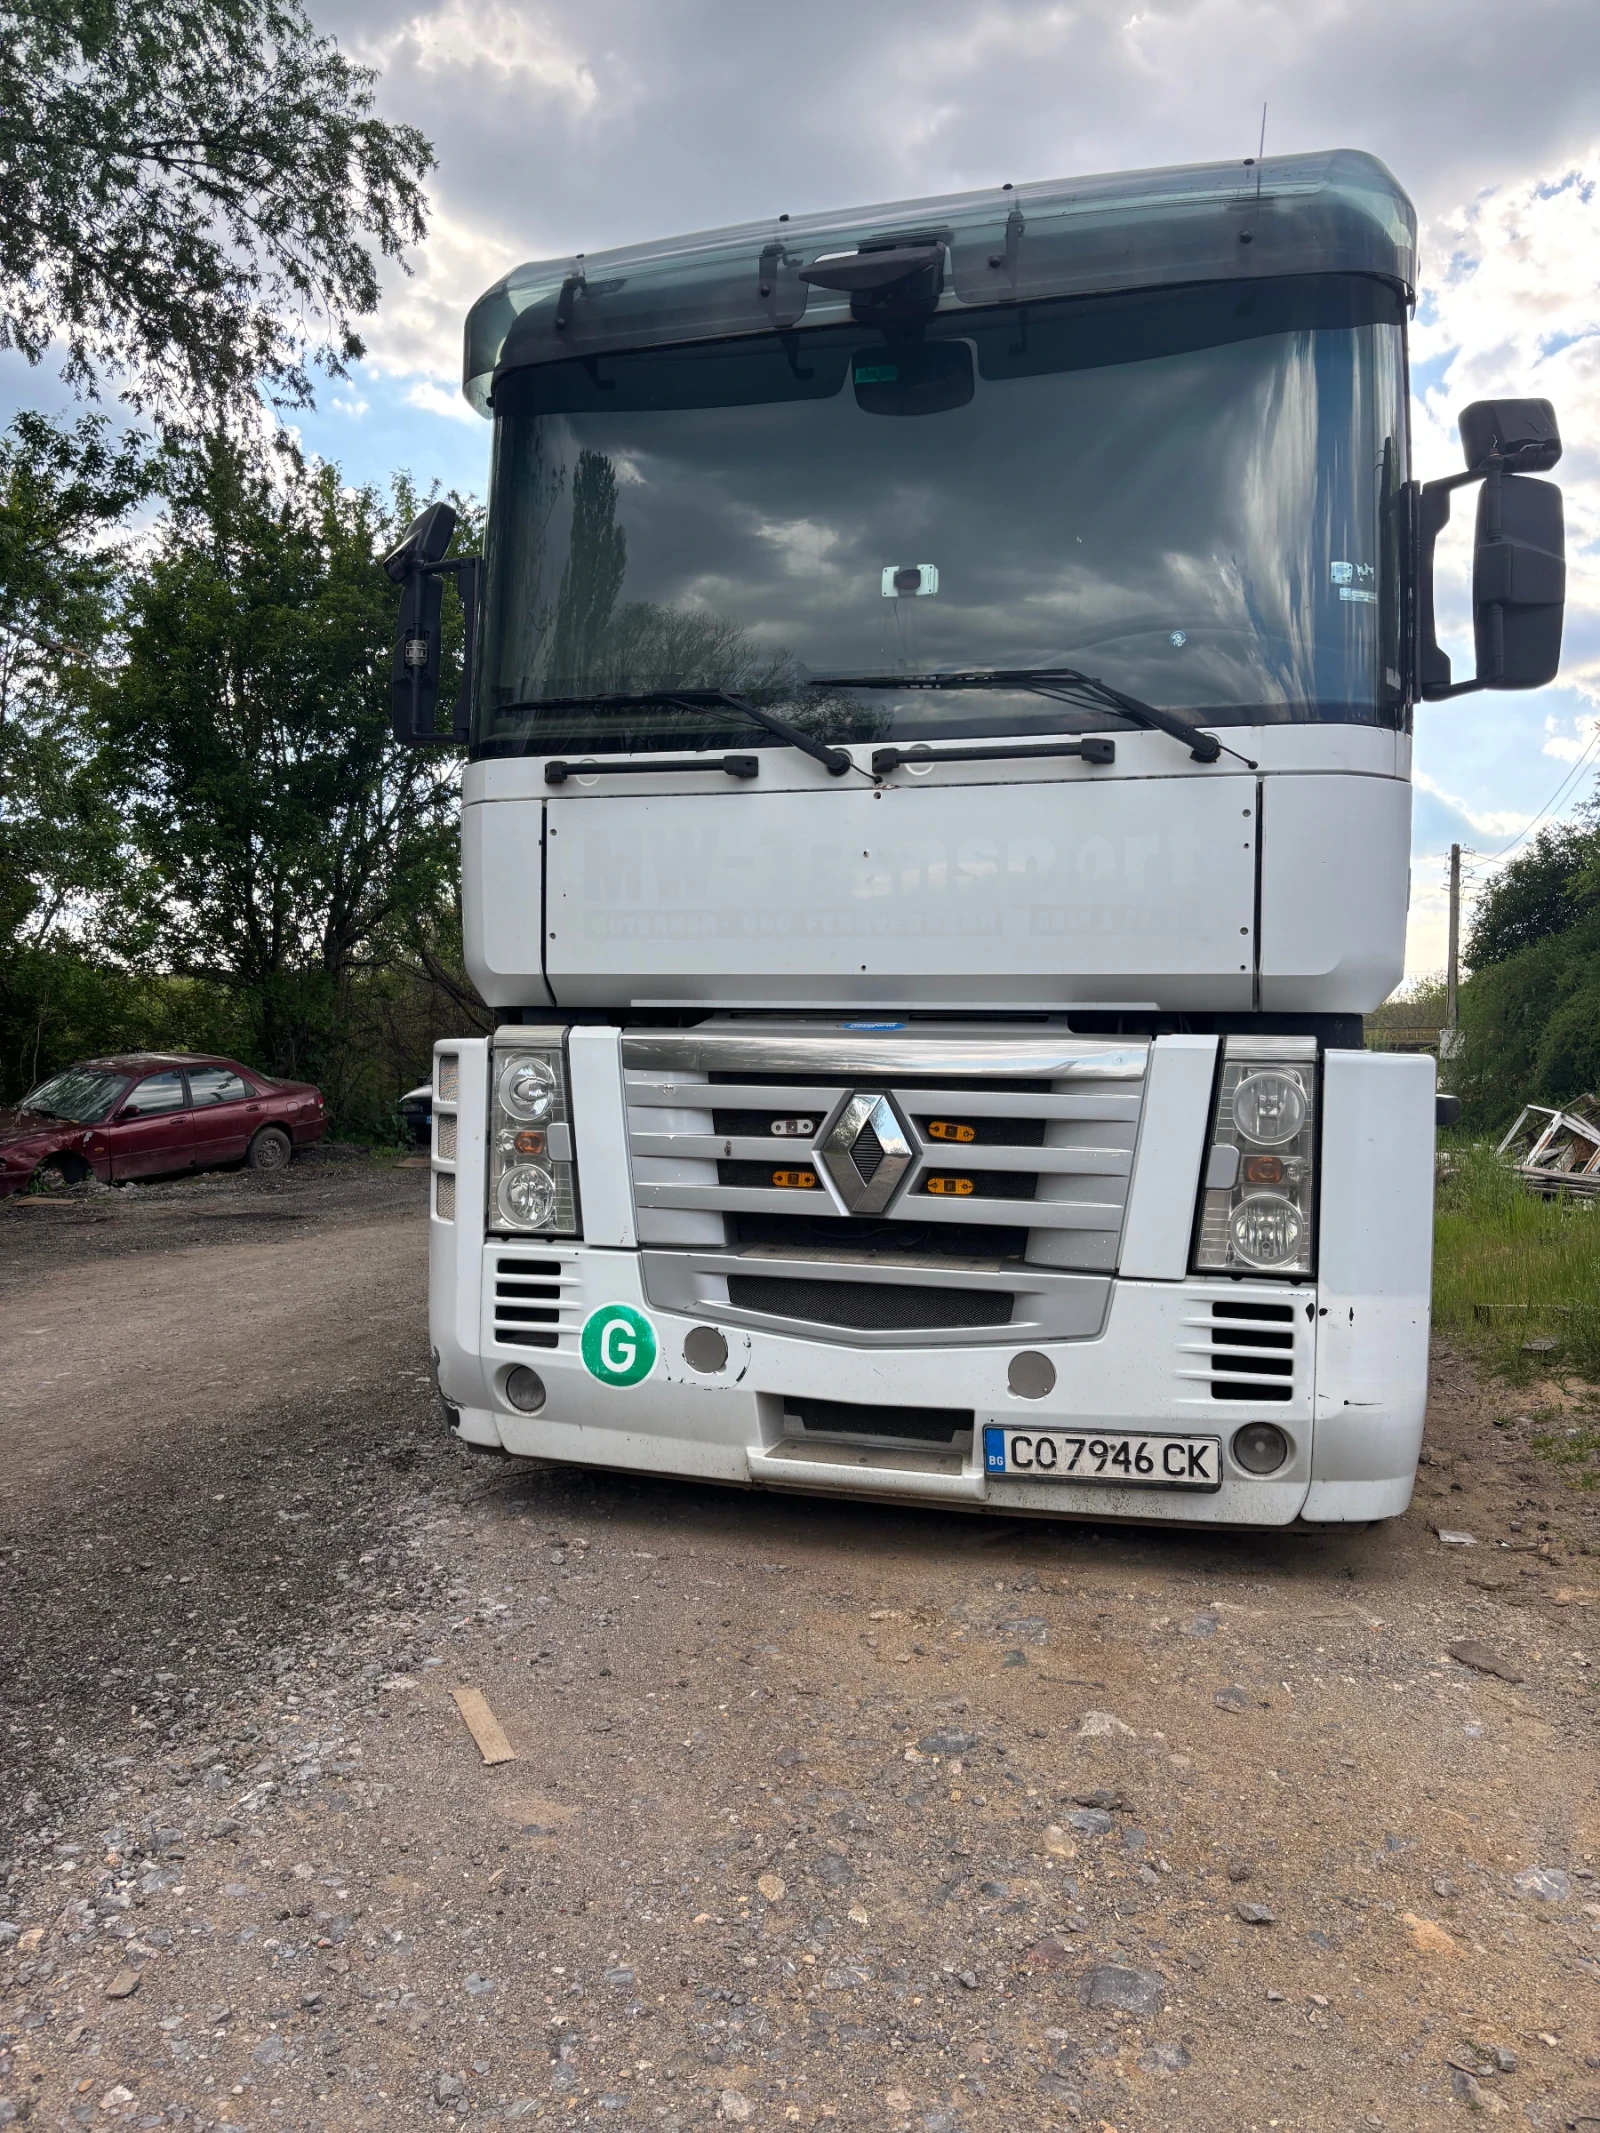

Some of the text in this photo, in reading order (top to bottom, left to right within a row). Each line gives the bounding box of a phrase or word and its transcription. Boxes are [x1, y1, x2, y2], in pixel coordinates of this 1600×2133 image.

[602, 1319, 637, 1373] G
[988, 1455, 1004, 1466] BG
[1010, 1435, 1211, 1478] CO 7946 CK
